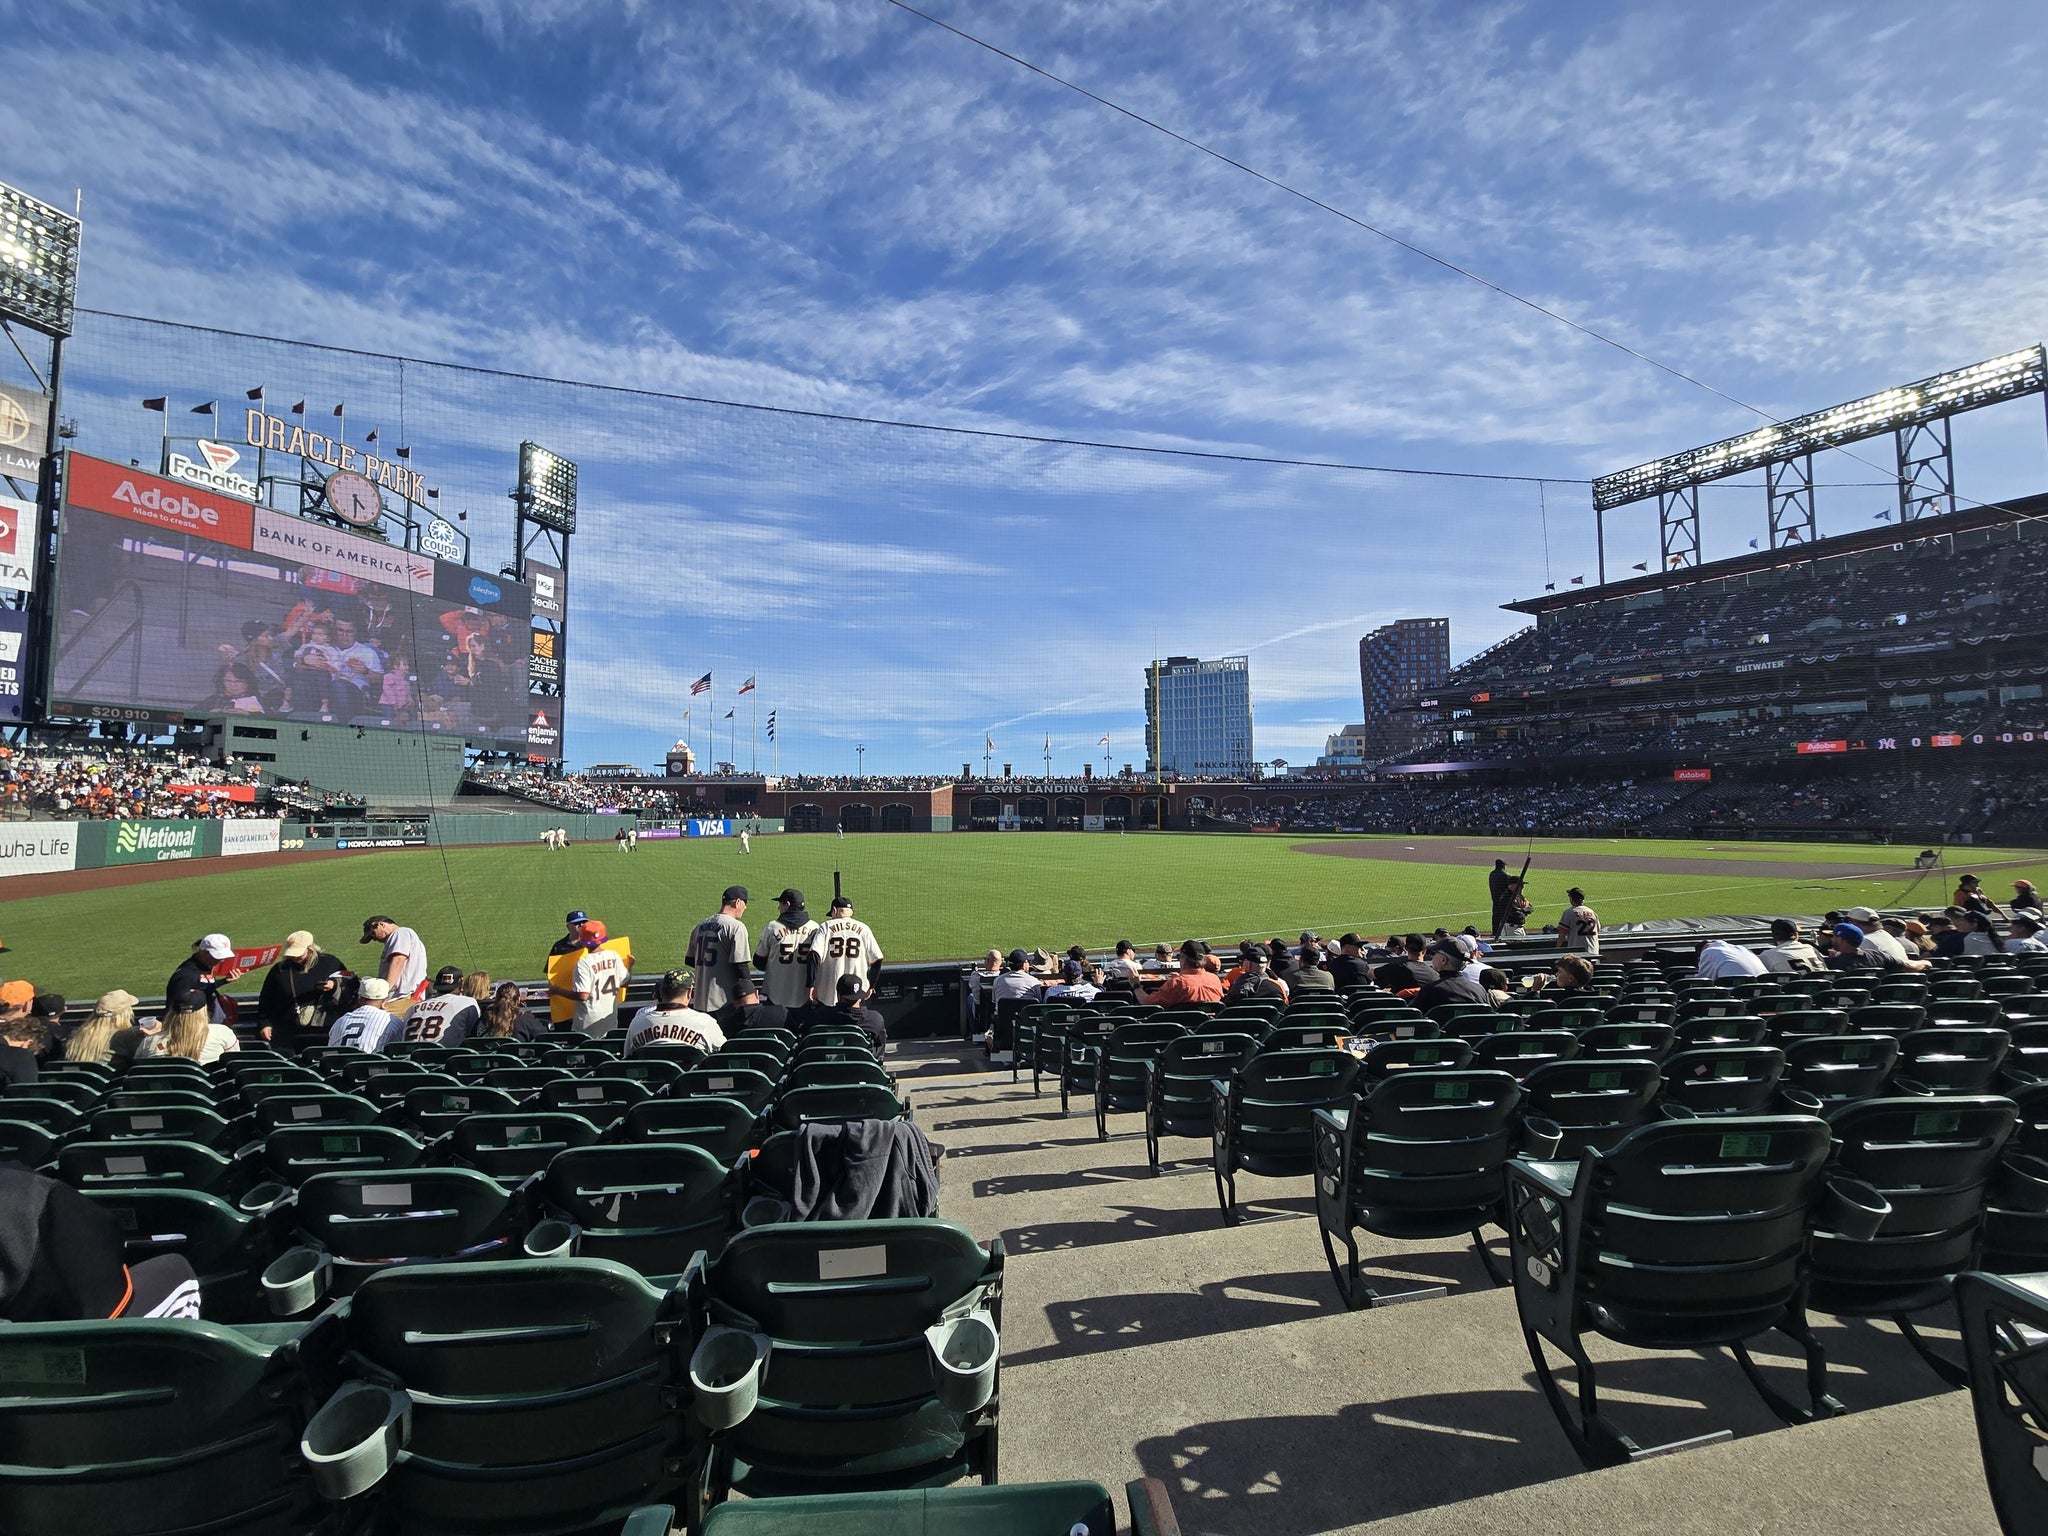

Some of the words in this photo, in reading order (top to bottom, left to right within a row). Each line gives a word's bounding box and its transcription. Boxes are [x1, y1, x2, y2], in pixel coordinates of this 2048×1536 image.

[6, 453, 41, 472] LAW
[246, 408, 357, 471] ORACLE
[365, 454, 425, 506] PARK
[173, 456, 260, 498] Fanatics
[112, 480, 219, 526] Adobe
[132, 506, 159, 519] Made
[159, 513, 169, 522] to
[170, 516, 200, 530] create.
[260, 527, 309, 549] BANK
[312, 542, 331, 554] OF
[336, 549, 403, 574] AMERICA
[423, 538, 459, 556] coupa
[0, 564, 30, 581] TA
[1736, 660, 1784, 673] CUTWATER
[91, 706, 150, 720] $20,910
[528, 726, 558, 737] enjamin
[1911, 738, 1921, 747] 0
[1973, 734, 1983, 744] 0
[2002, 733, 2013, 742] 0
[2022, 732, 2033, 741] 0
[1027, 785, 1089, 794] LANDING
[138, 825, 197, 849] National
[696, 820, 725, 836] VISA
[41, 838, 70, 856] Life
[224, 835, 239, 844] BANK
[247, 833, 269, 842] AMERICA
[281, 839, 304, 849] 399
[347, 840, 375, 848] KONICA
[157, 850, 170, 861] Car
[170, 848, 192, 860] Rental
[829, 923, 863, 936] WILSON
[1576, 918, 1597, 936] 22
[697, 936, 718, 967] 15
[779, 943, 808, 965] 55
[829, 937, 861, 959] 38
[591, 959, 617, 974] BAILEY
[595, 974, 617, 1001] 14
[414, 1002, 448, 1013] POSEY
[341, 1022, 366, 1046] 2
[404, 1016, 444, 1040] 28
[1535, 1262, 1543, 1277] 9
